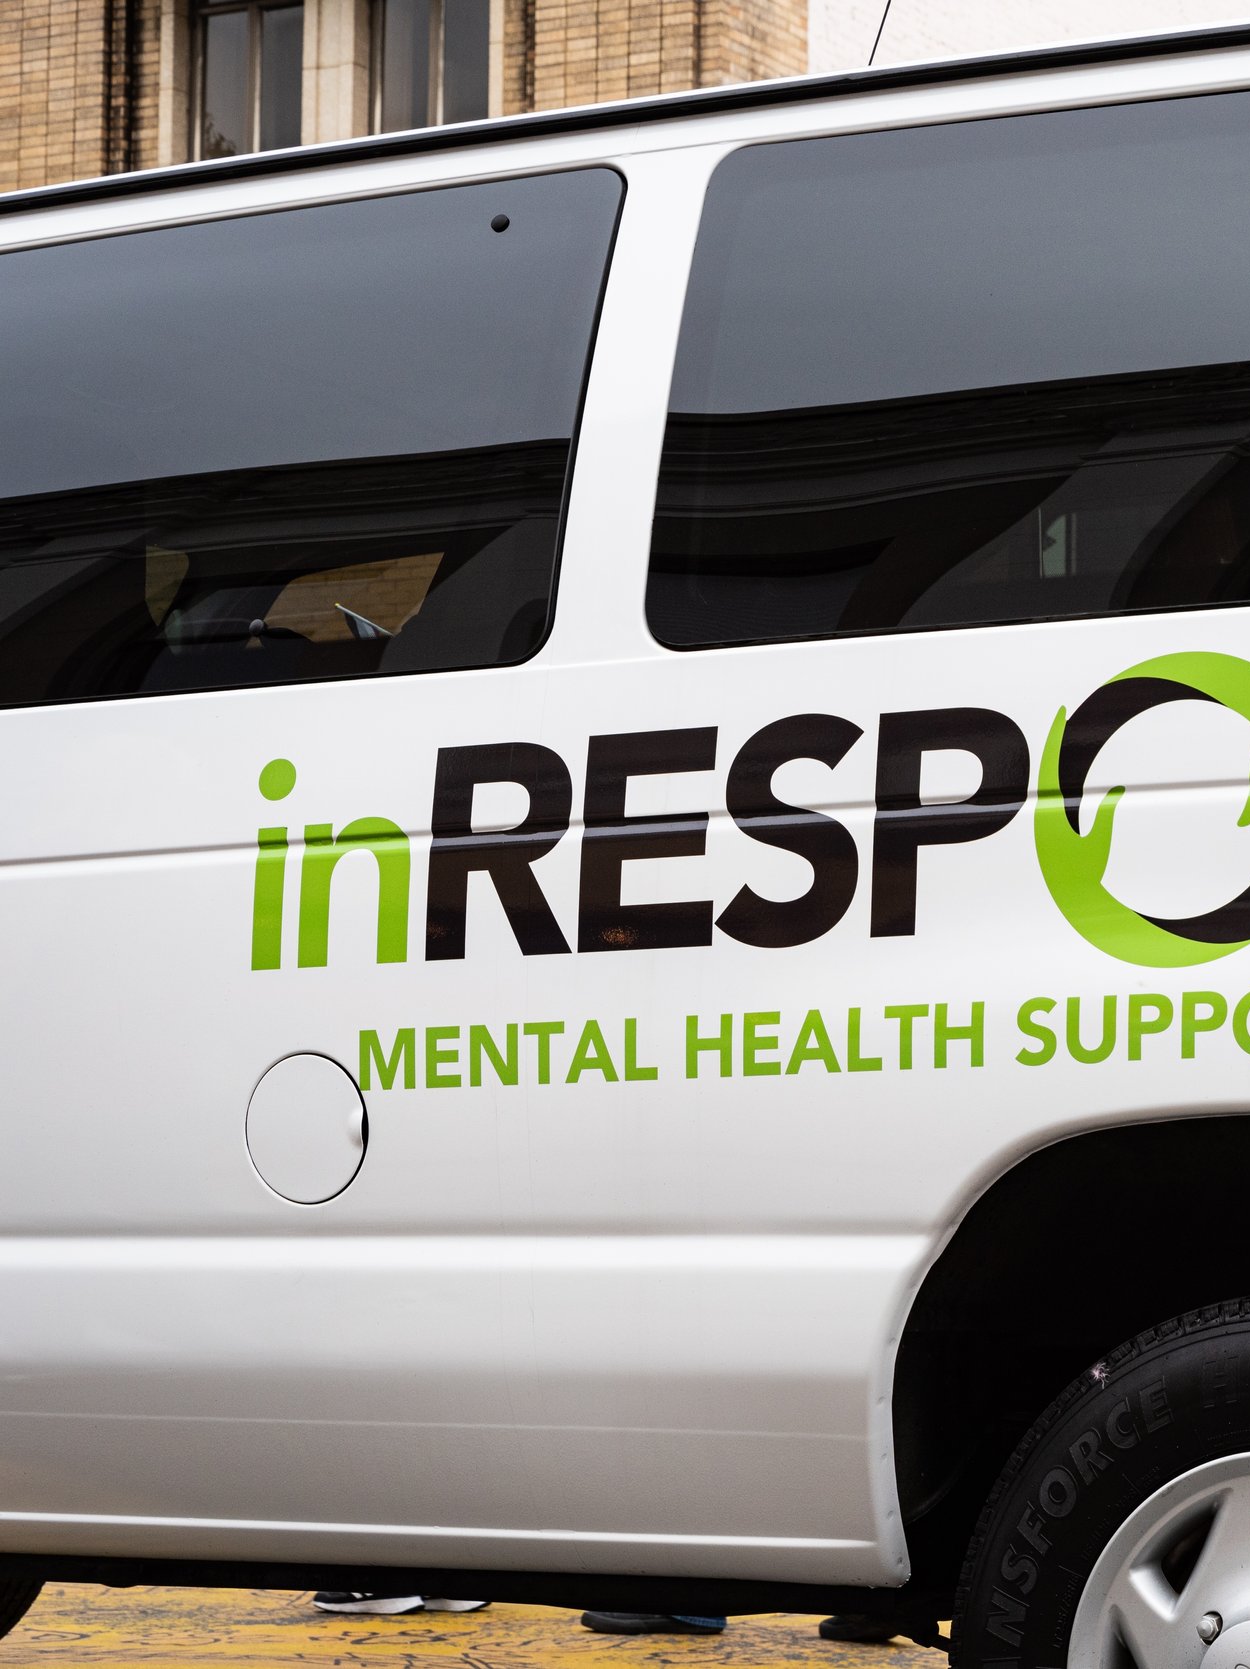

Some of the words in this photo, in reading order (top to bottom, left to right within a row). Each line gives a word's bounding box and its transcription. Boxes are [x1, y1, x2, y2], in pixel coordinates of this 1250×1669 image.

[358, 1018, 659, 1092] MENTAL
[685, 1001, 986, 1080] HEALTH
[981, 1374, 1178, 1669] NSFORCE
